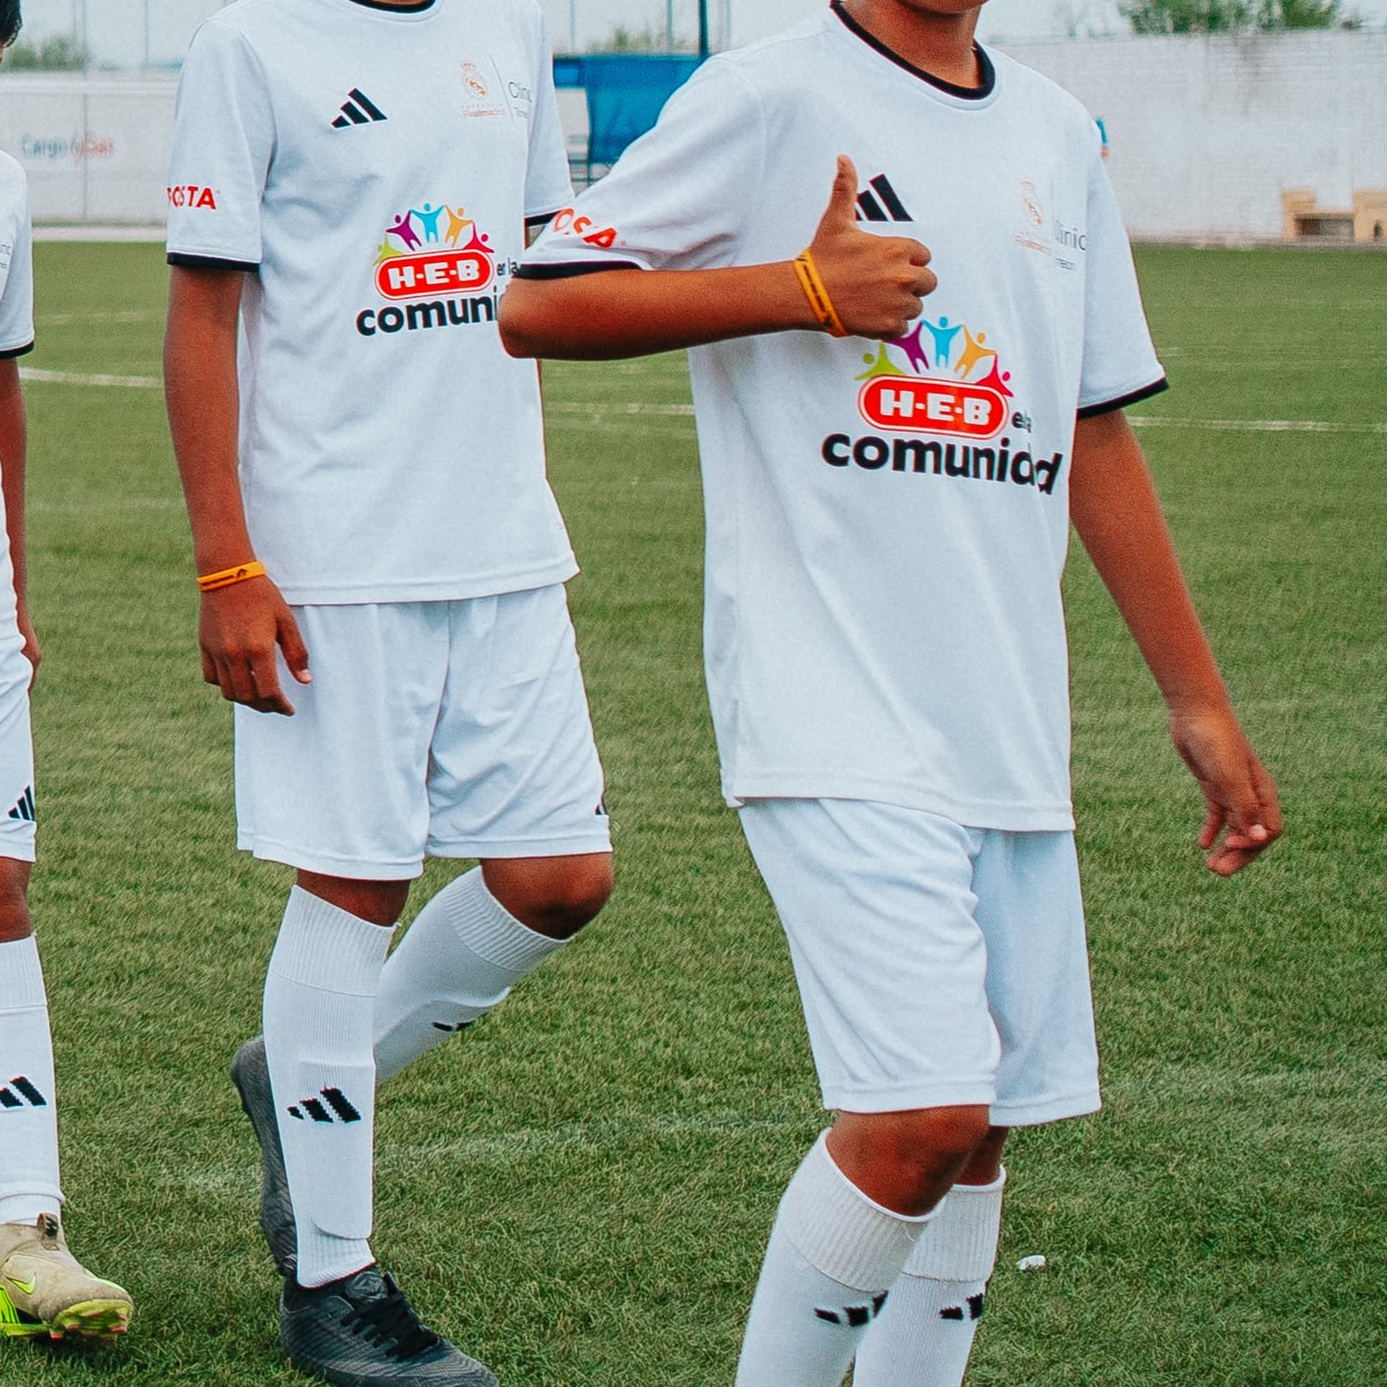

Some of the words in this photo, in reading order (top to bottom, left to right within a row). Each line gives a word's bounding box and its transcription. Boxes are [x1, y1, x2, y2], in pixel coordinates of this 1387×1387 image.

[387, 259, 479, 289] H-E-B
[356, 285, 498, 336] comuni
[879, 389, 992, 425] H-E-B
